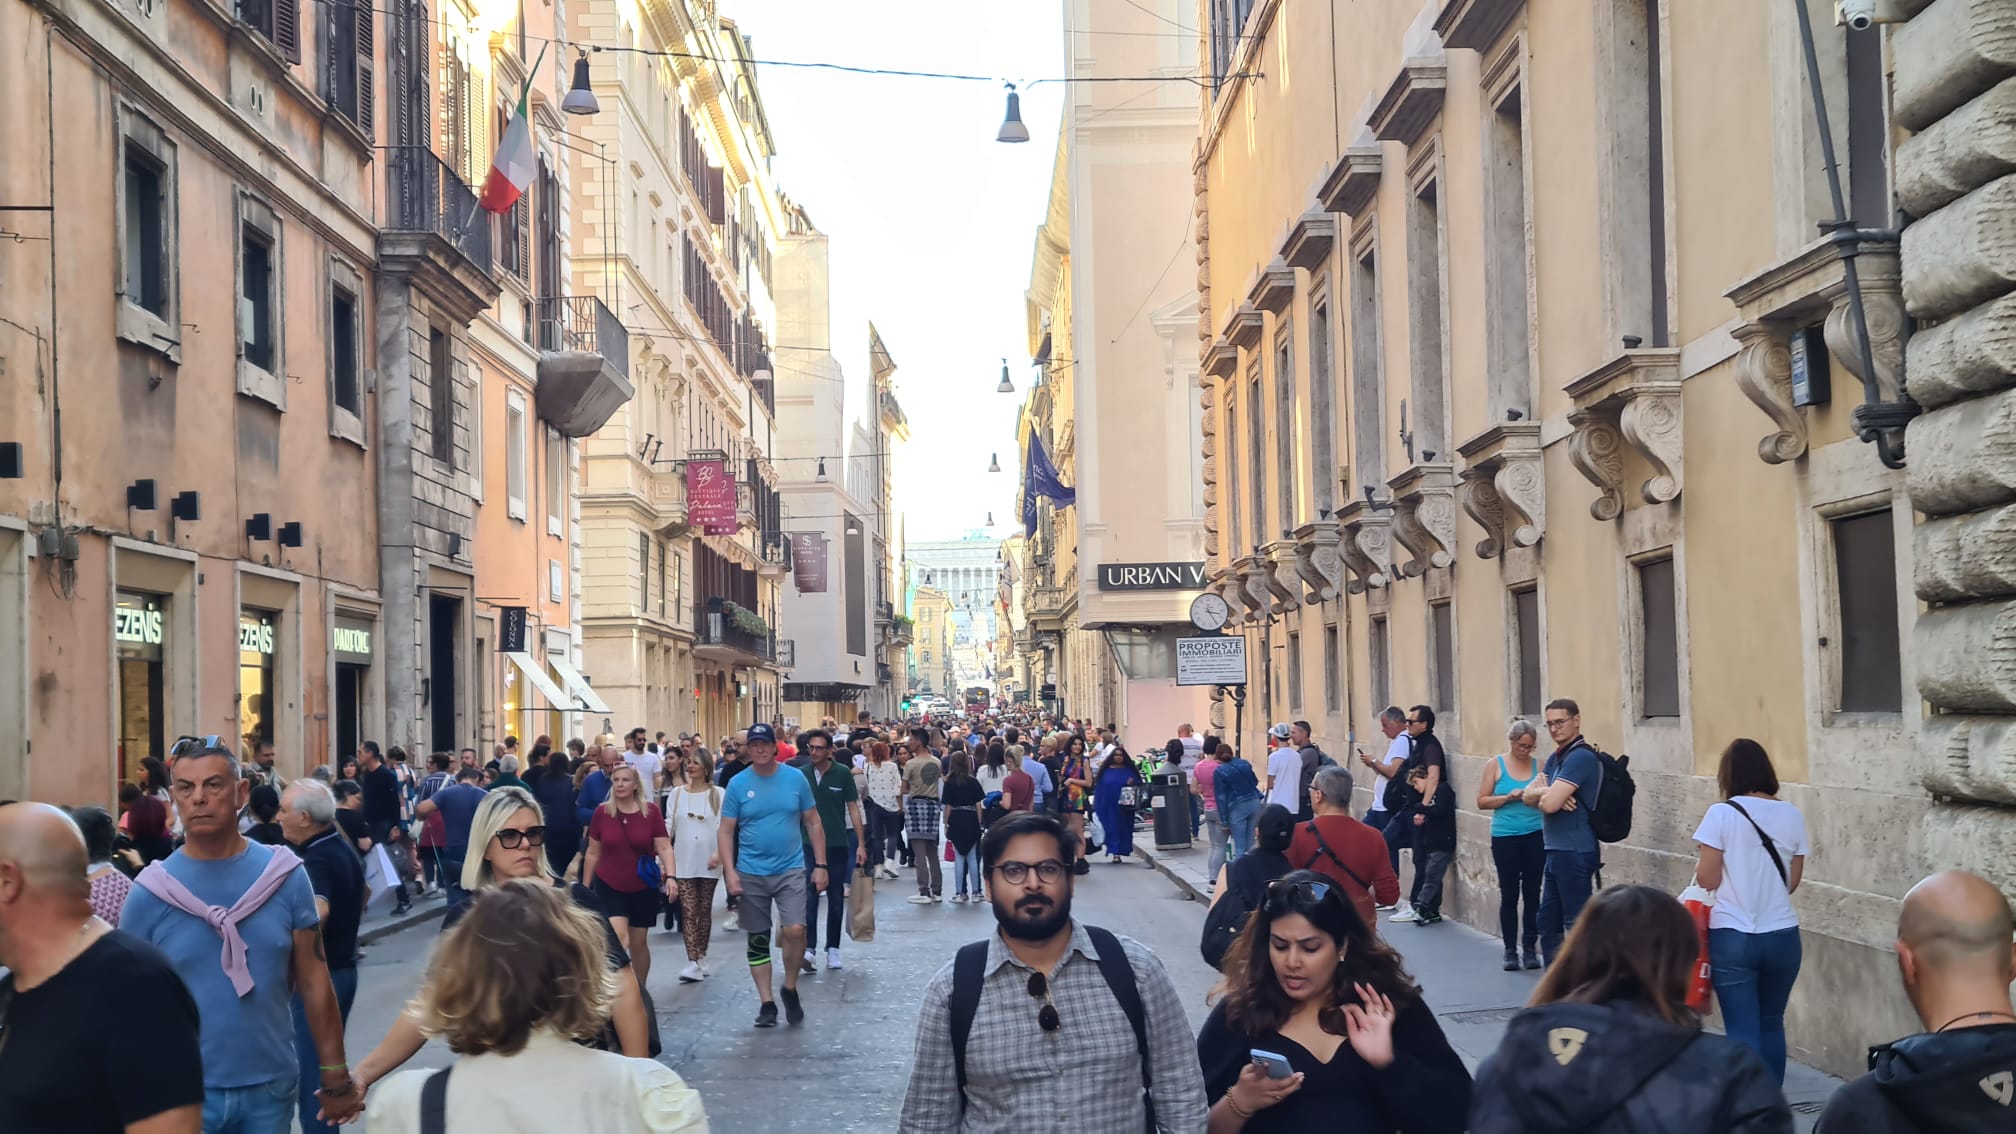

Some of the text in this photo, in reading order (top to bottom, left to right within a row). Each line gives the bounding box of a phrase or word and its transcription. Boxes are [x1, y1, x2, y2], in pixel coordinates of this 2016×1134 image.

[1108, 566, 1210, 585] URBAN V
[508, 610, 517, 649] COLONNA
[1179, 642, 1241, 650] PROPOSTE
